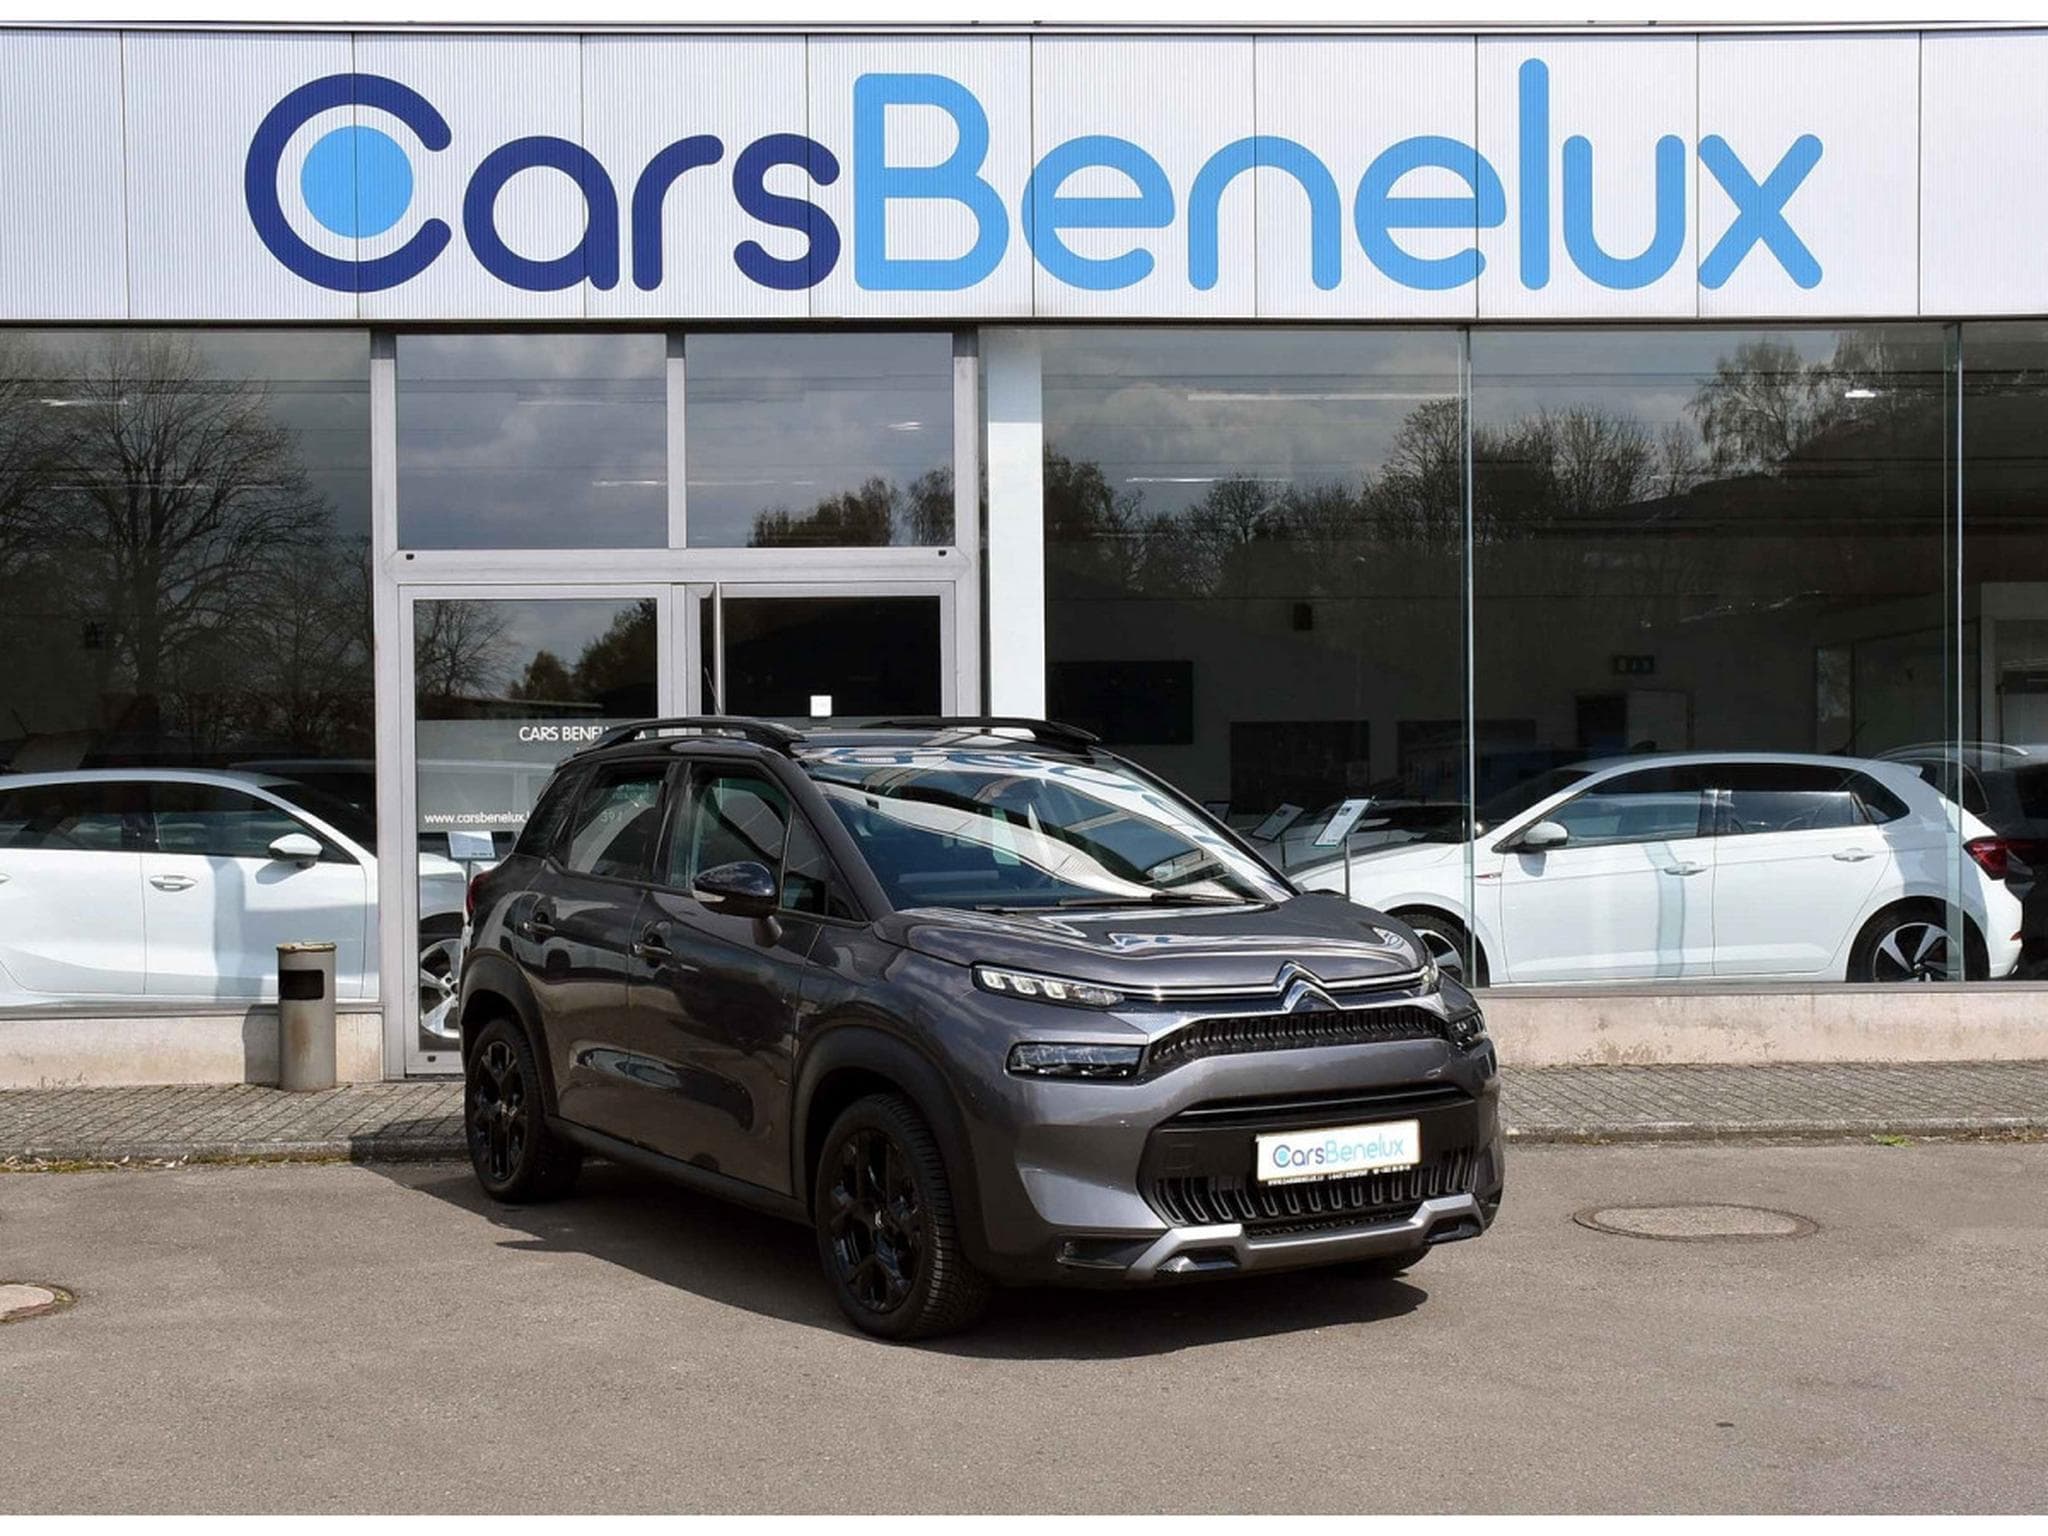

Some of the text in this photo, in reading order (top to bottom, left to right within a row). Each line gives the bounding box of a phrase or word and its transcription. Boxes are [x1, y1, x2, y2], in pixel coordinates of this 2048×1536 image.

[244, 58, 1823, 293] CarsBenelux
[518, 725, 559, 741] CARS
[561, 725, 611, 741] BENE
[424, 809, 530, 824] www.carsbenelux.l
[1272, 1133, 1405, 1169] CarsBenelux
